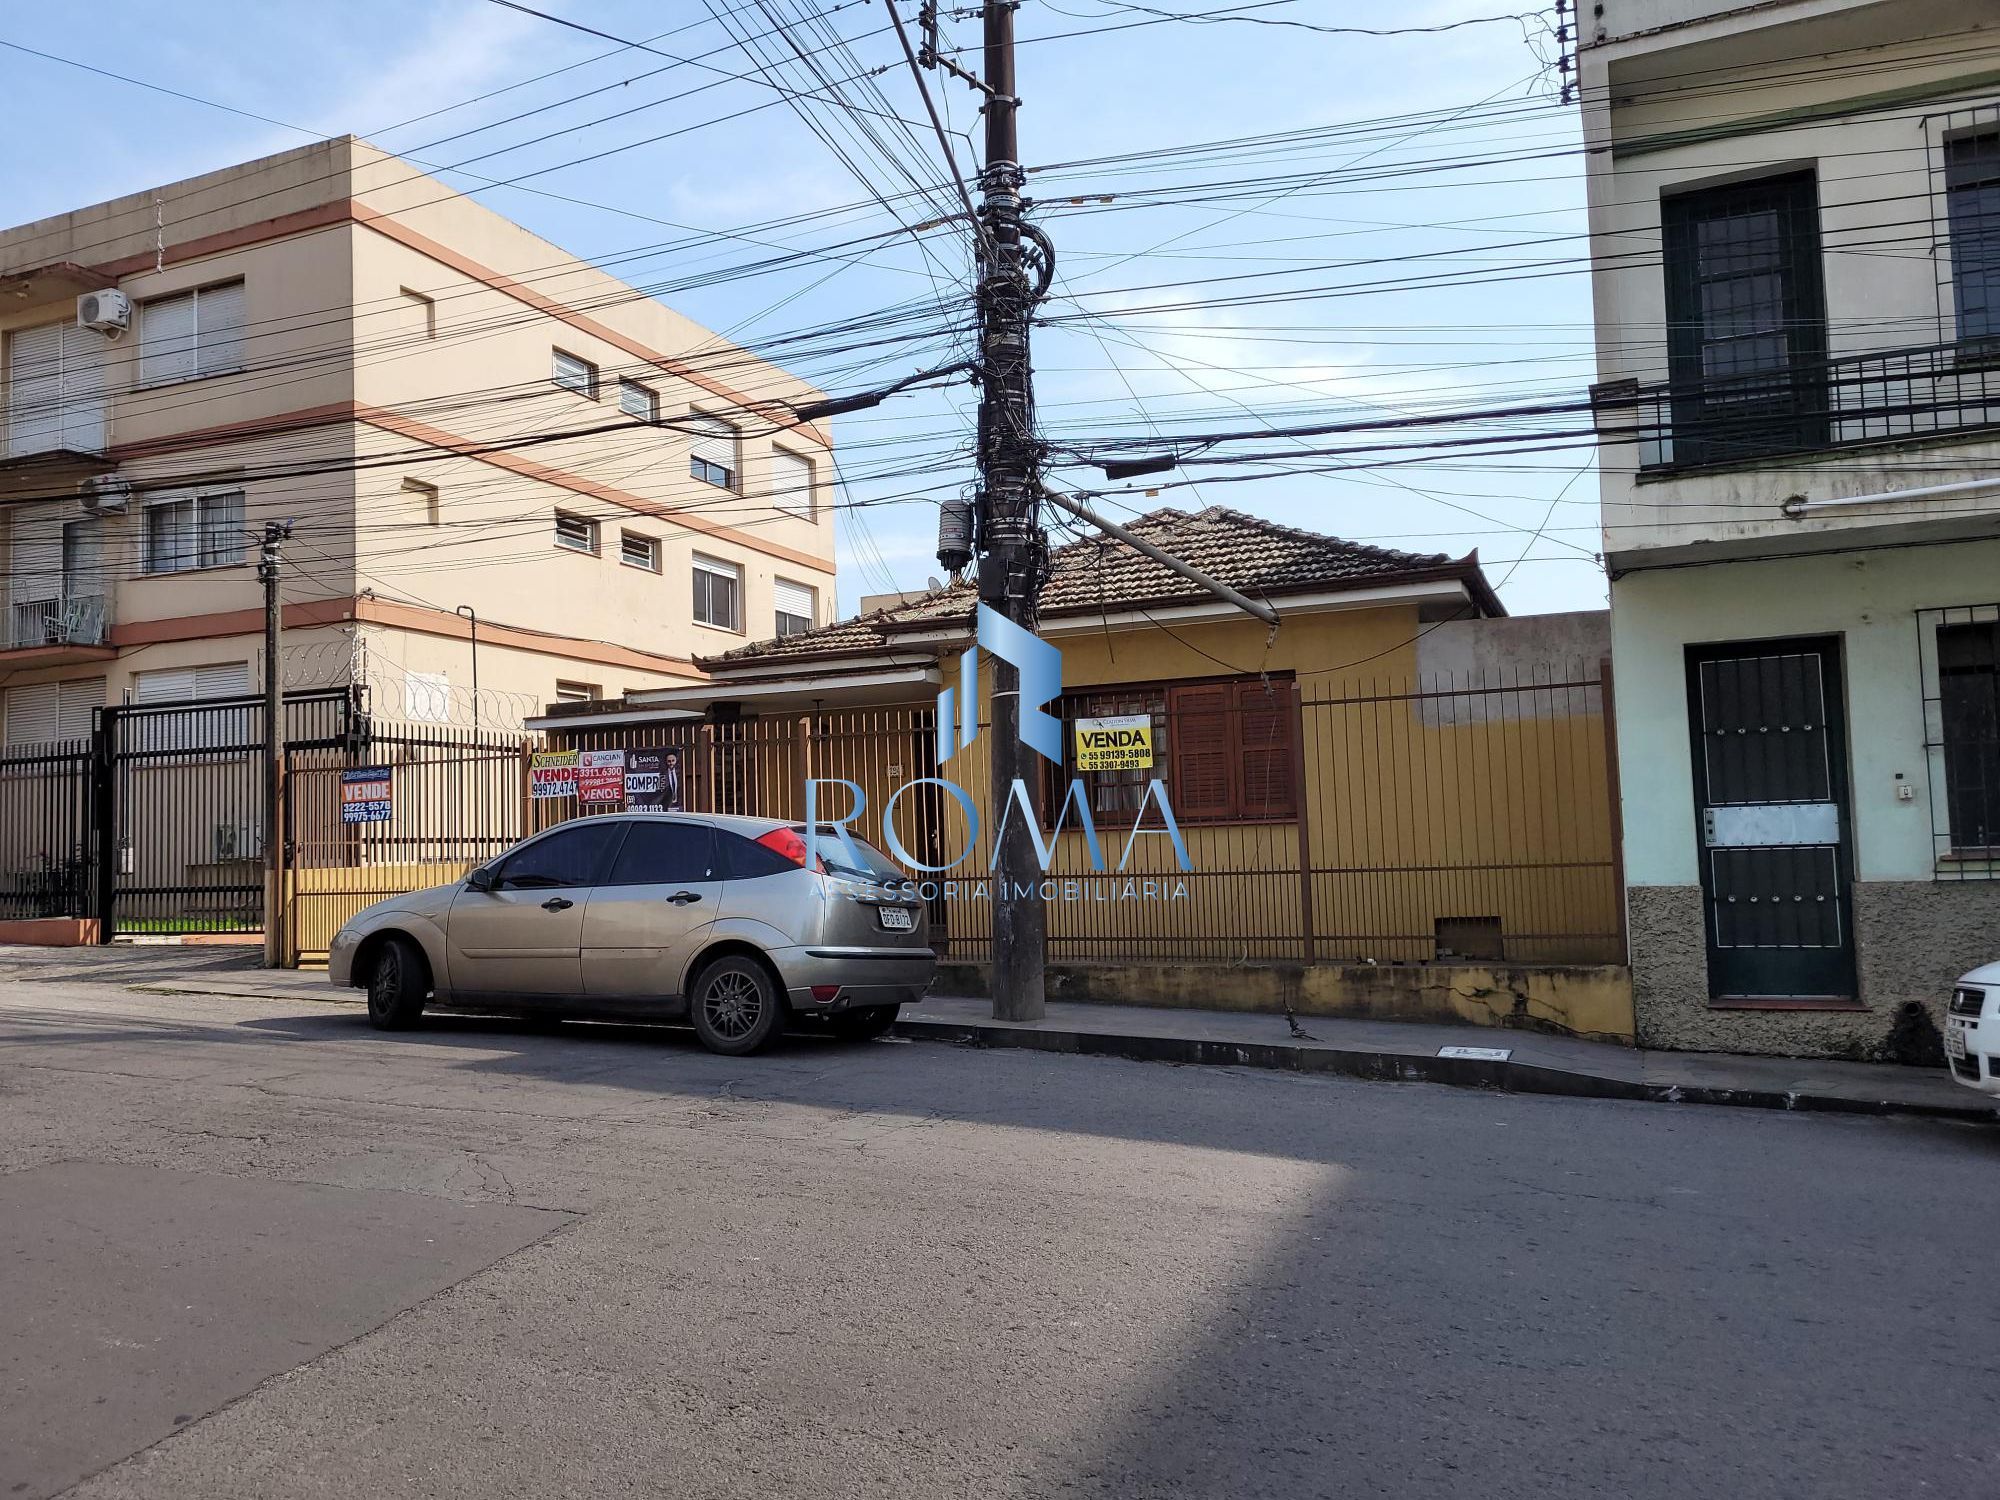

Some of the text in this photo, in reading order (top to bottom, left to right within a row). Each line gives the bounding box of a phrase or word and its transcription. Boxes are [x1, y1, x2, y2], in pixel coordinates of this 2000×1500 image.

[1081, 730, 1146, 749] VENDA
[534, 754, 578, 768] SCHNEIDER
[1088, 749, 1151, 760] 55 99139-5808
[1088, 761, 1099, 770] 55
[533, 767, 579, 783] VENDE
[343, 781, 391, 801] VENDE
[533, 781, 578, 797] 99972.4747
[581, 787, 621, 801] VENDE
[343, 800, 391, 812] 3222-5578
[343, 810, 391, 822] 99975-6677
